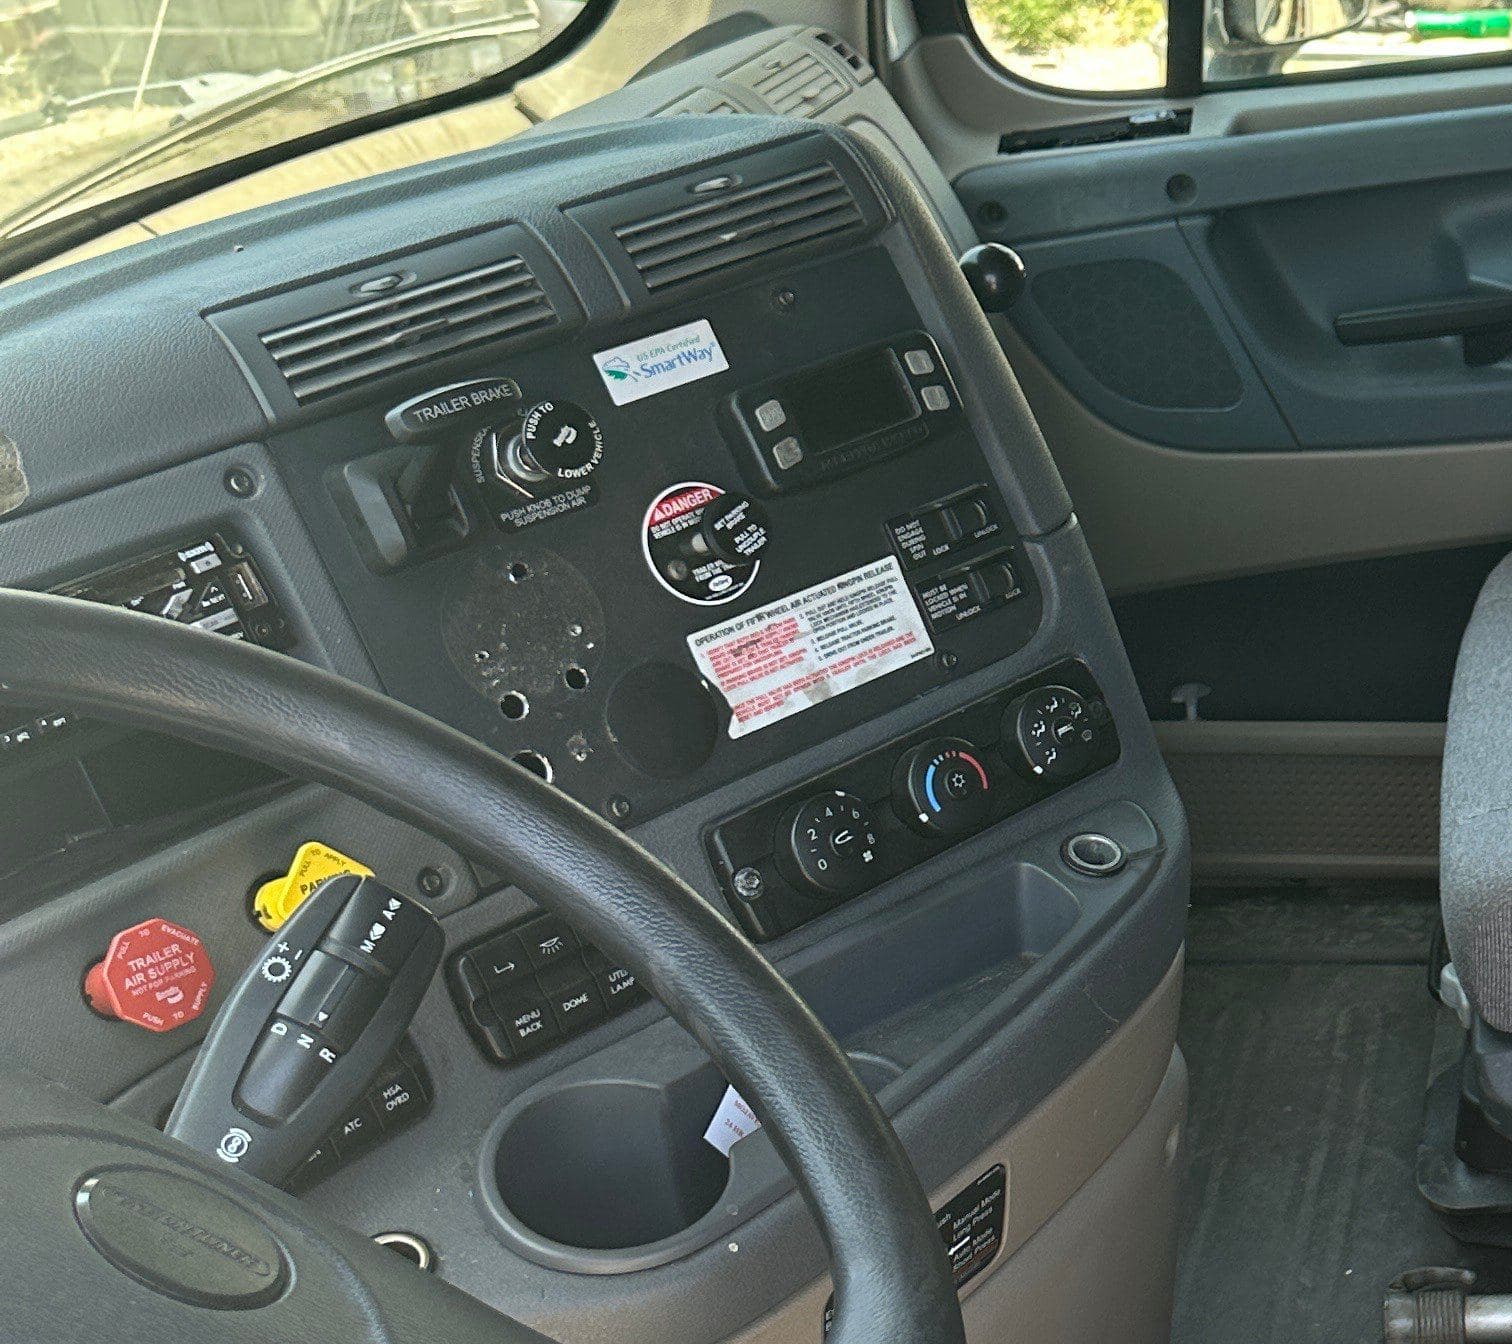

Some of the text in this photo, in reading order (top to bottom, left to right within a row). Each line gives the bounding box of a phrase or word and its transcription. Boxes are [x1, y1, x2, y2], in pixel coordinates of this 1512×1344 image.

[413, 384, 514, 424] TRAILER BRAKE
[526, 402, 554, 439] PUSH TO
[557, 462, 594, 478] LOWER
[500, 507, 527, 522] PUSH
[526, 498, 552, 512] KNOB
[552, 494, 566, 504] TO
[661, 488, 714, 516] DANGER
[514, 496, 587, 527] SUSPENSION AIR
[912, 550, 927, 561] OUT
[932, 543, 950, 556] LOCK
[694, 625, 735, 646] OPERATION
[734, 621, 745, 630] OF
[789, 599, 802, 609] AIR
[862, 562, 894, 579] RELEASE
[955, 605, 981, 620] UNLOCK
[852, 808, 860, 819] 6
[807, 828, 818, 841] 2
[867, 833, 875, 845] 8
[818, 858, 828, 870] 0
[382, 909, 396, 921] A
[360, 939, 376, 954] M
[127, 943, 182, 972] TRAILER
[124, 952, 195, 990] AIR SUPPLY
[131, 984, 148, 997] NOT
[148, 979, 164, 990] FOR
[610, 976, 635, 995] LAMP
[562, 993, 589, 1012] DOME
[142, 1012, 165, 1026] PUSH
[172, 1010, 185, 1020] TO
[514, 1008, 541, 1028] MENU
[270, 1022, 288, 1036] D
[518, 1021, 543, 1038] BACK
[297, 1033, 314, 1049] N
[319, 1047, 337, 1064] R
[343, 1117, 363, 1135] ATC
